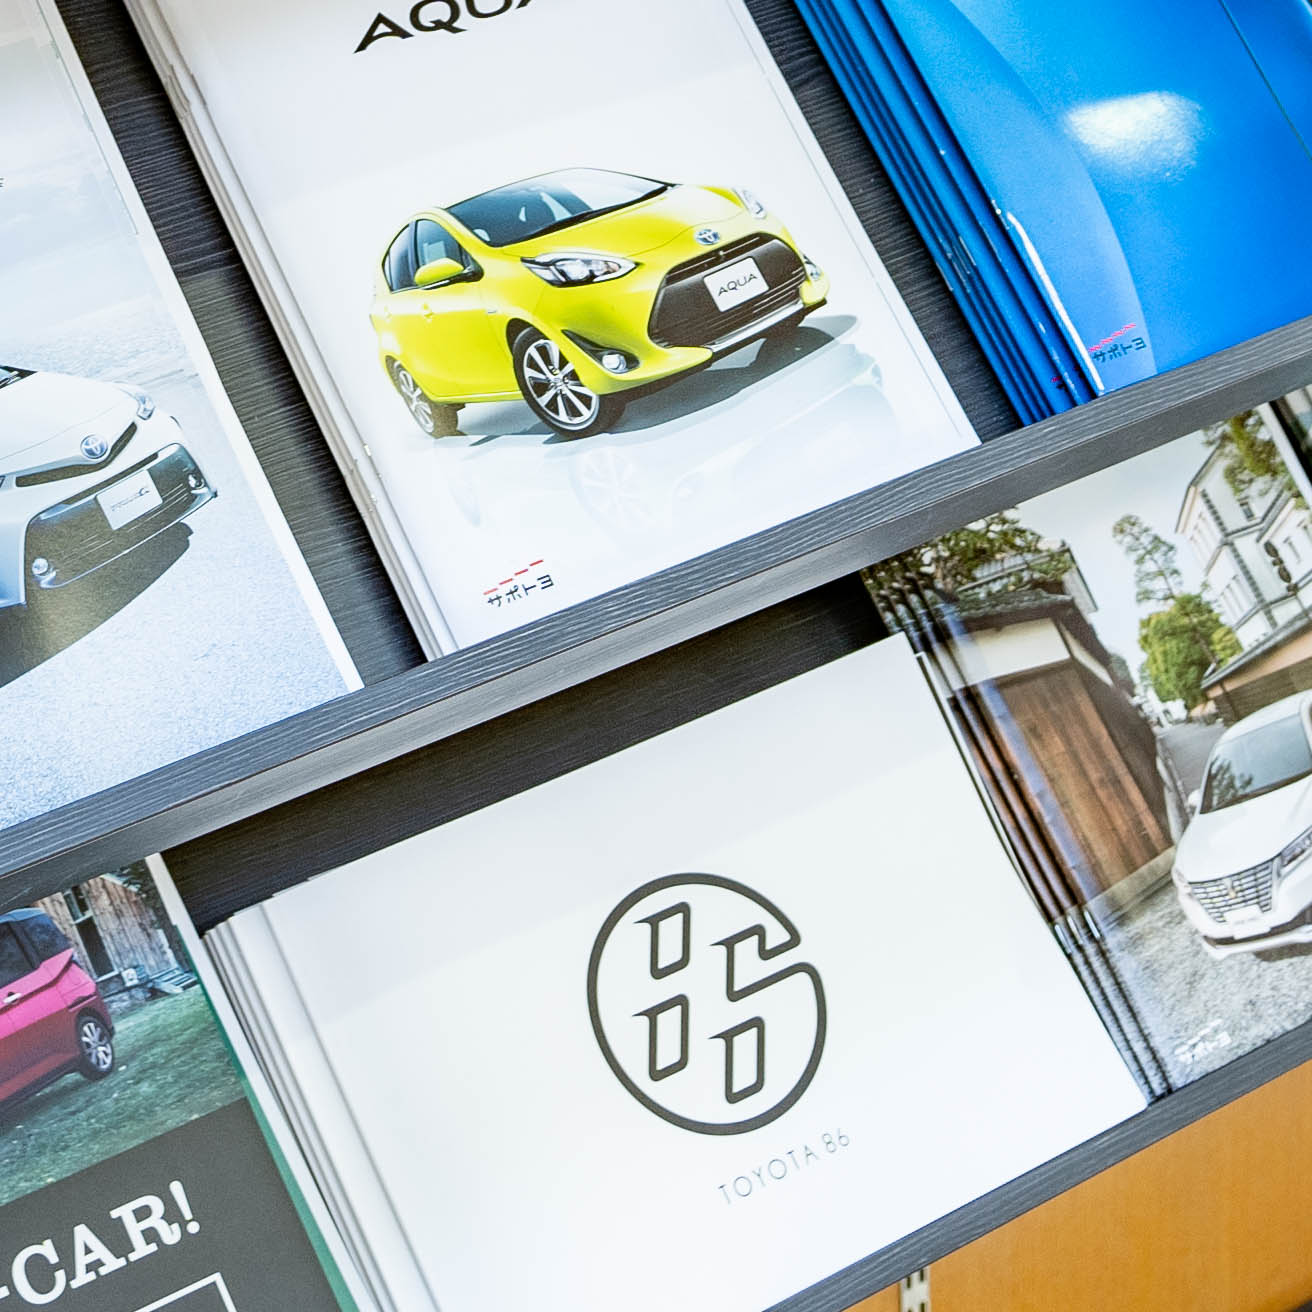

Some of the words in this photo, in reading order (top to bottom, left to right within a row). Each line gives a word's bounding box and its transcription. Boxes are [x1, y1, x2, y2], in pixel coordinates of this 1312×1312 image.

[718, 274, 757, 296] AQUA
[1093, 337, 1146, 364] サポトヨ
[487, 574, 554, 607] サポトヨ
[718, 1144, 819, 1205] TOYOTA
[821, 1127, 850, 1153] 86
